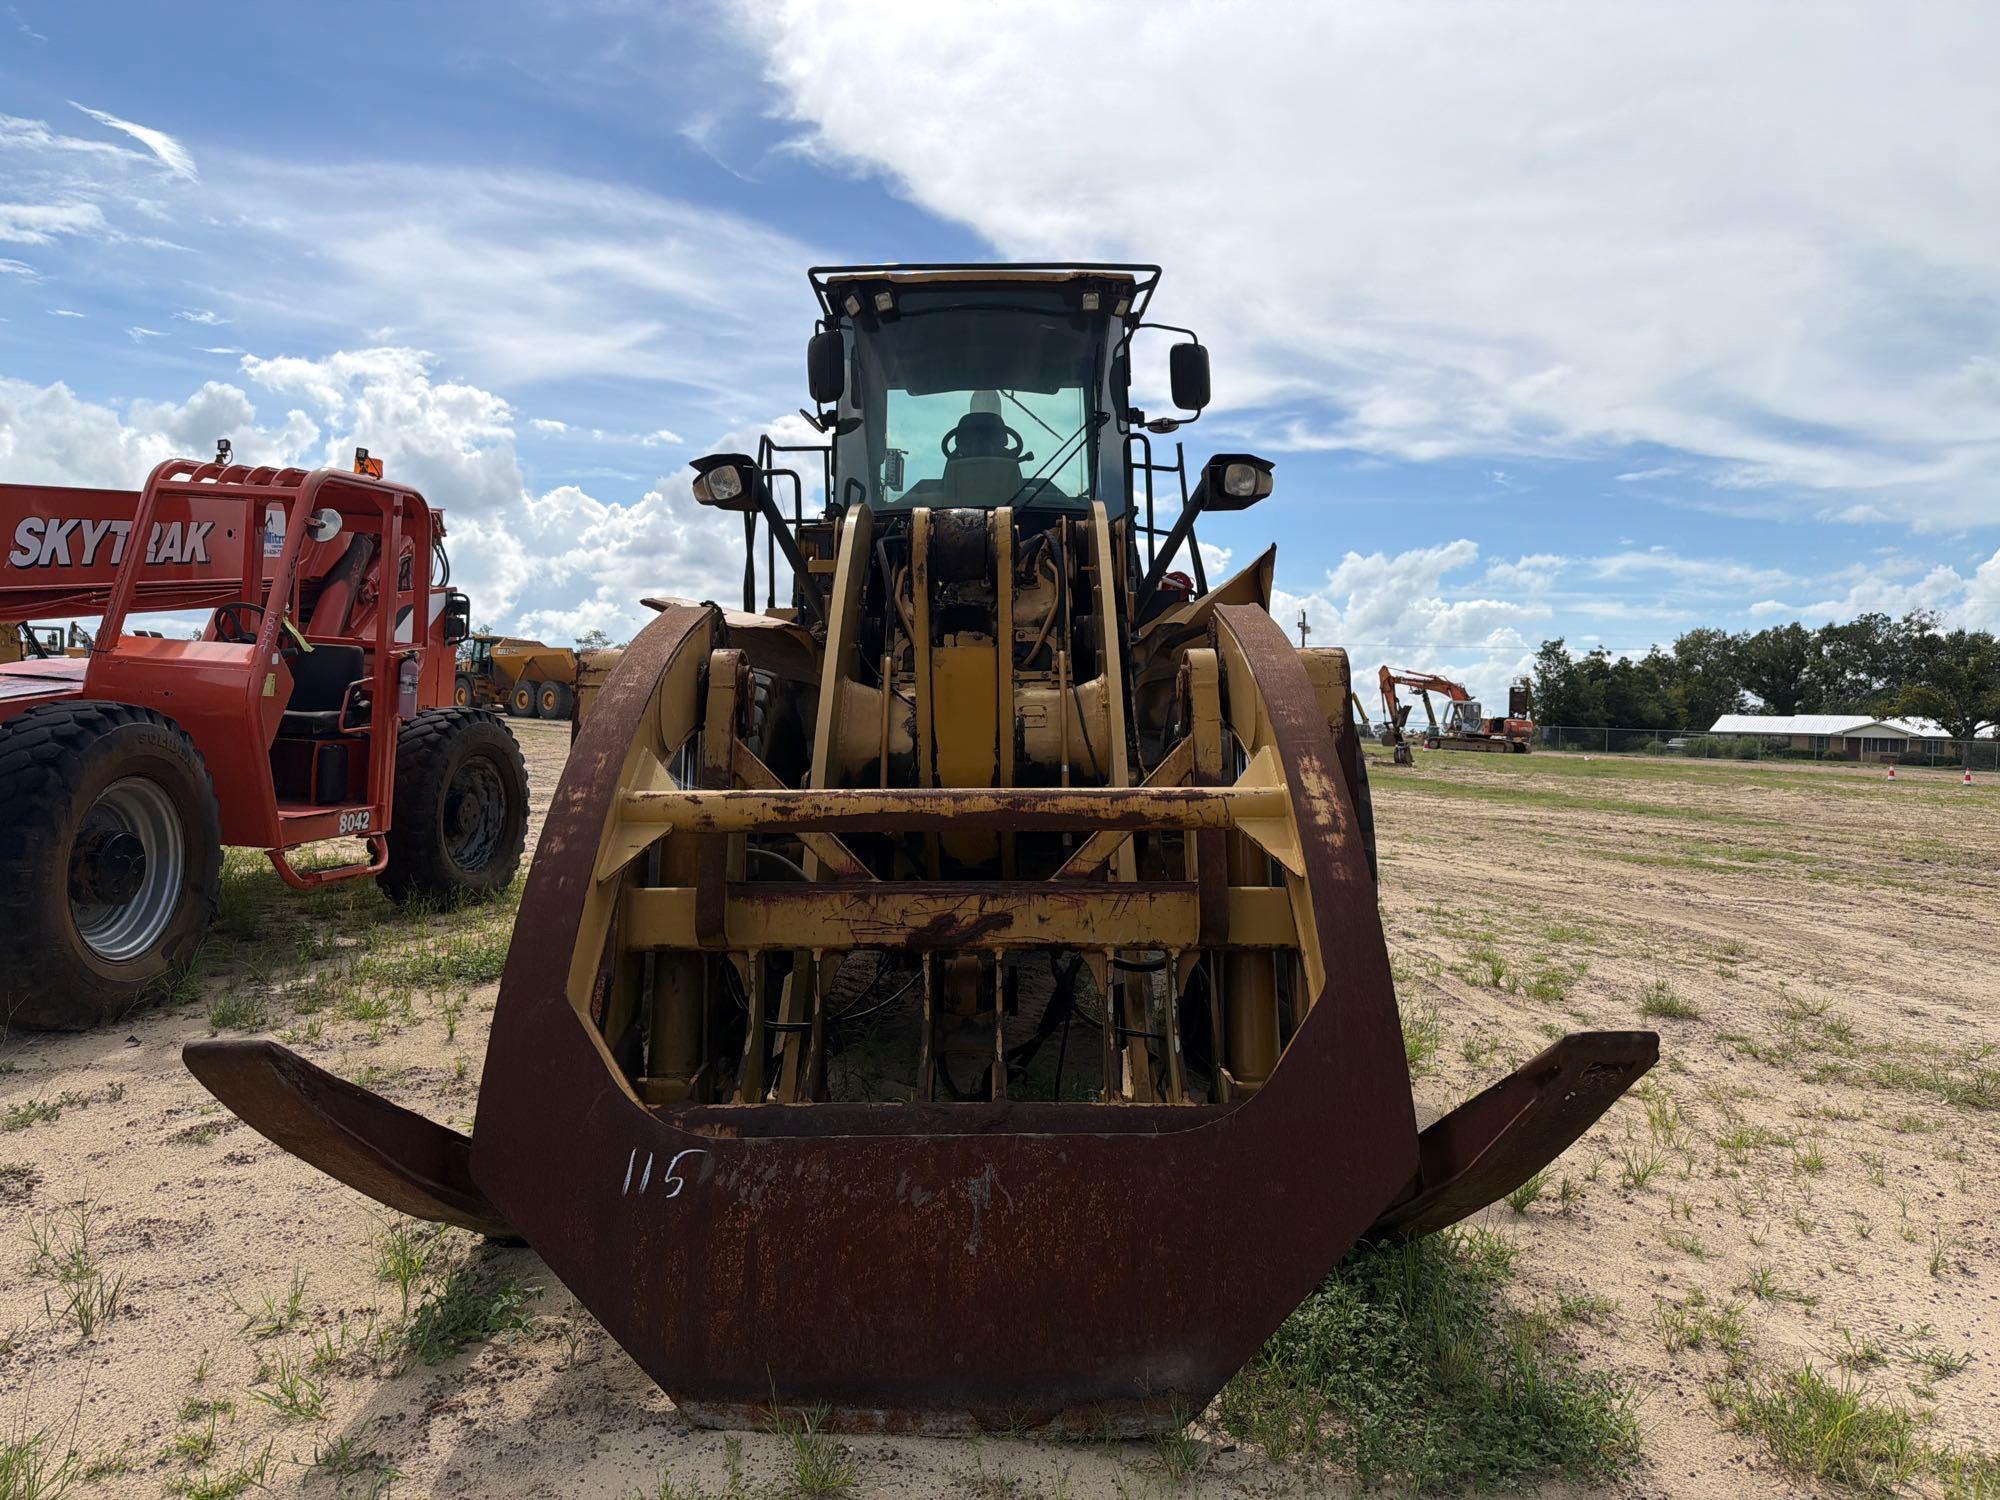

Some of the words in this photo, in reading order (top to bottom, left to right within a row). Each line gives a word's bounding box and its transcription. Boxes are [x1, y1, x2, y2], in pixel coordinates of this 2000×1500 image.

[10, 516, 215, 568] SKYTRAK
[339, 811, 370, 834] 8042
[622, 1147, 708, 1199] 115
